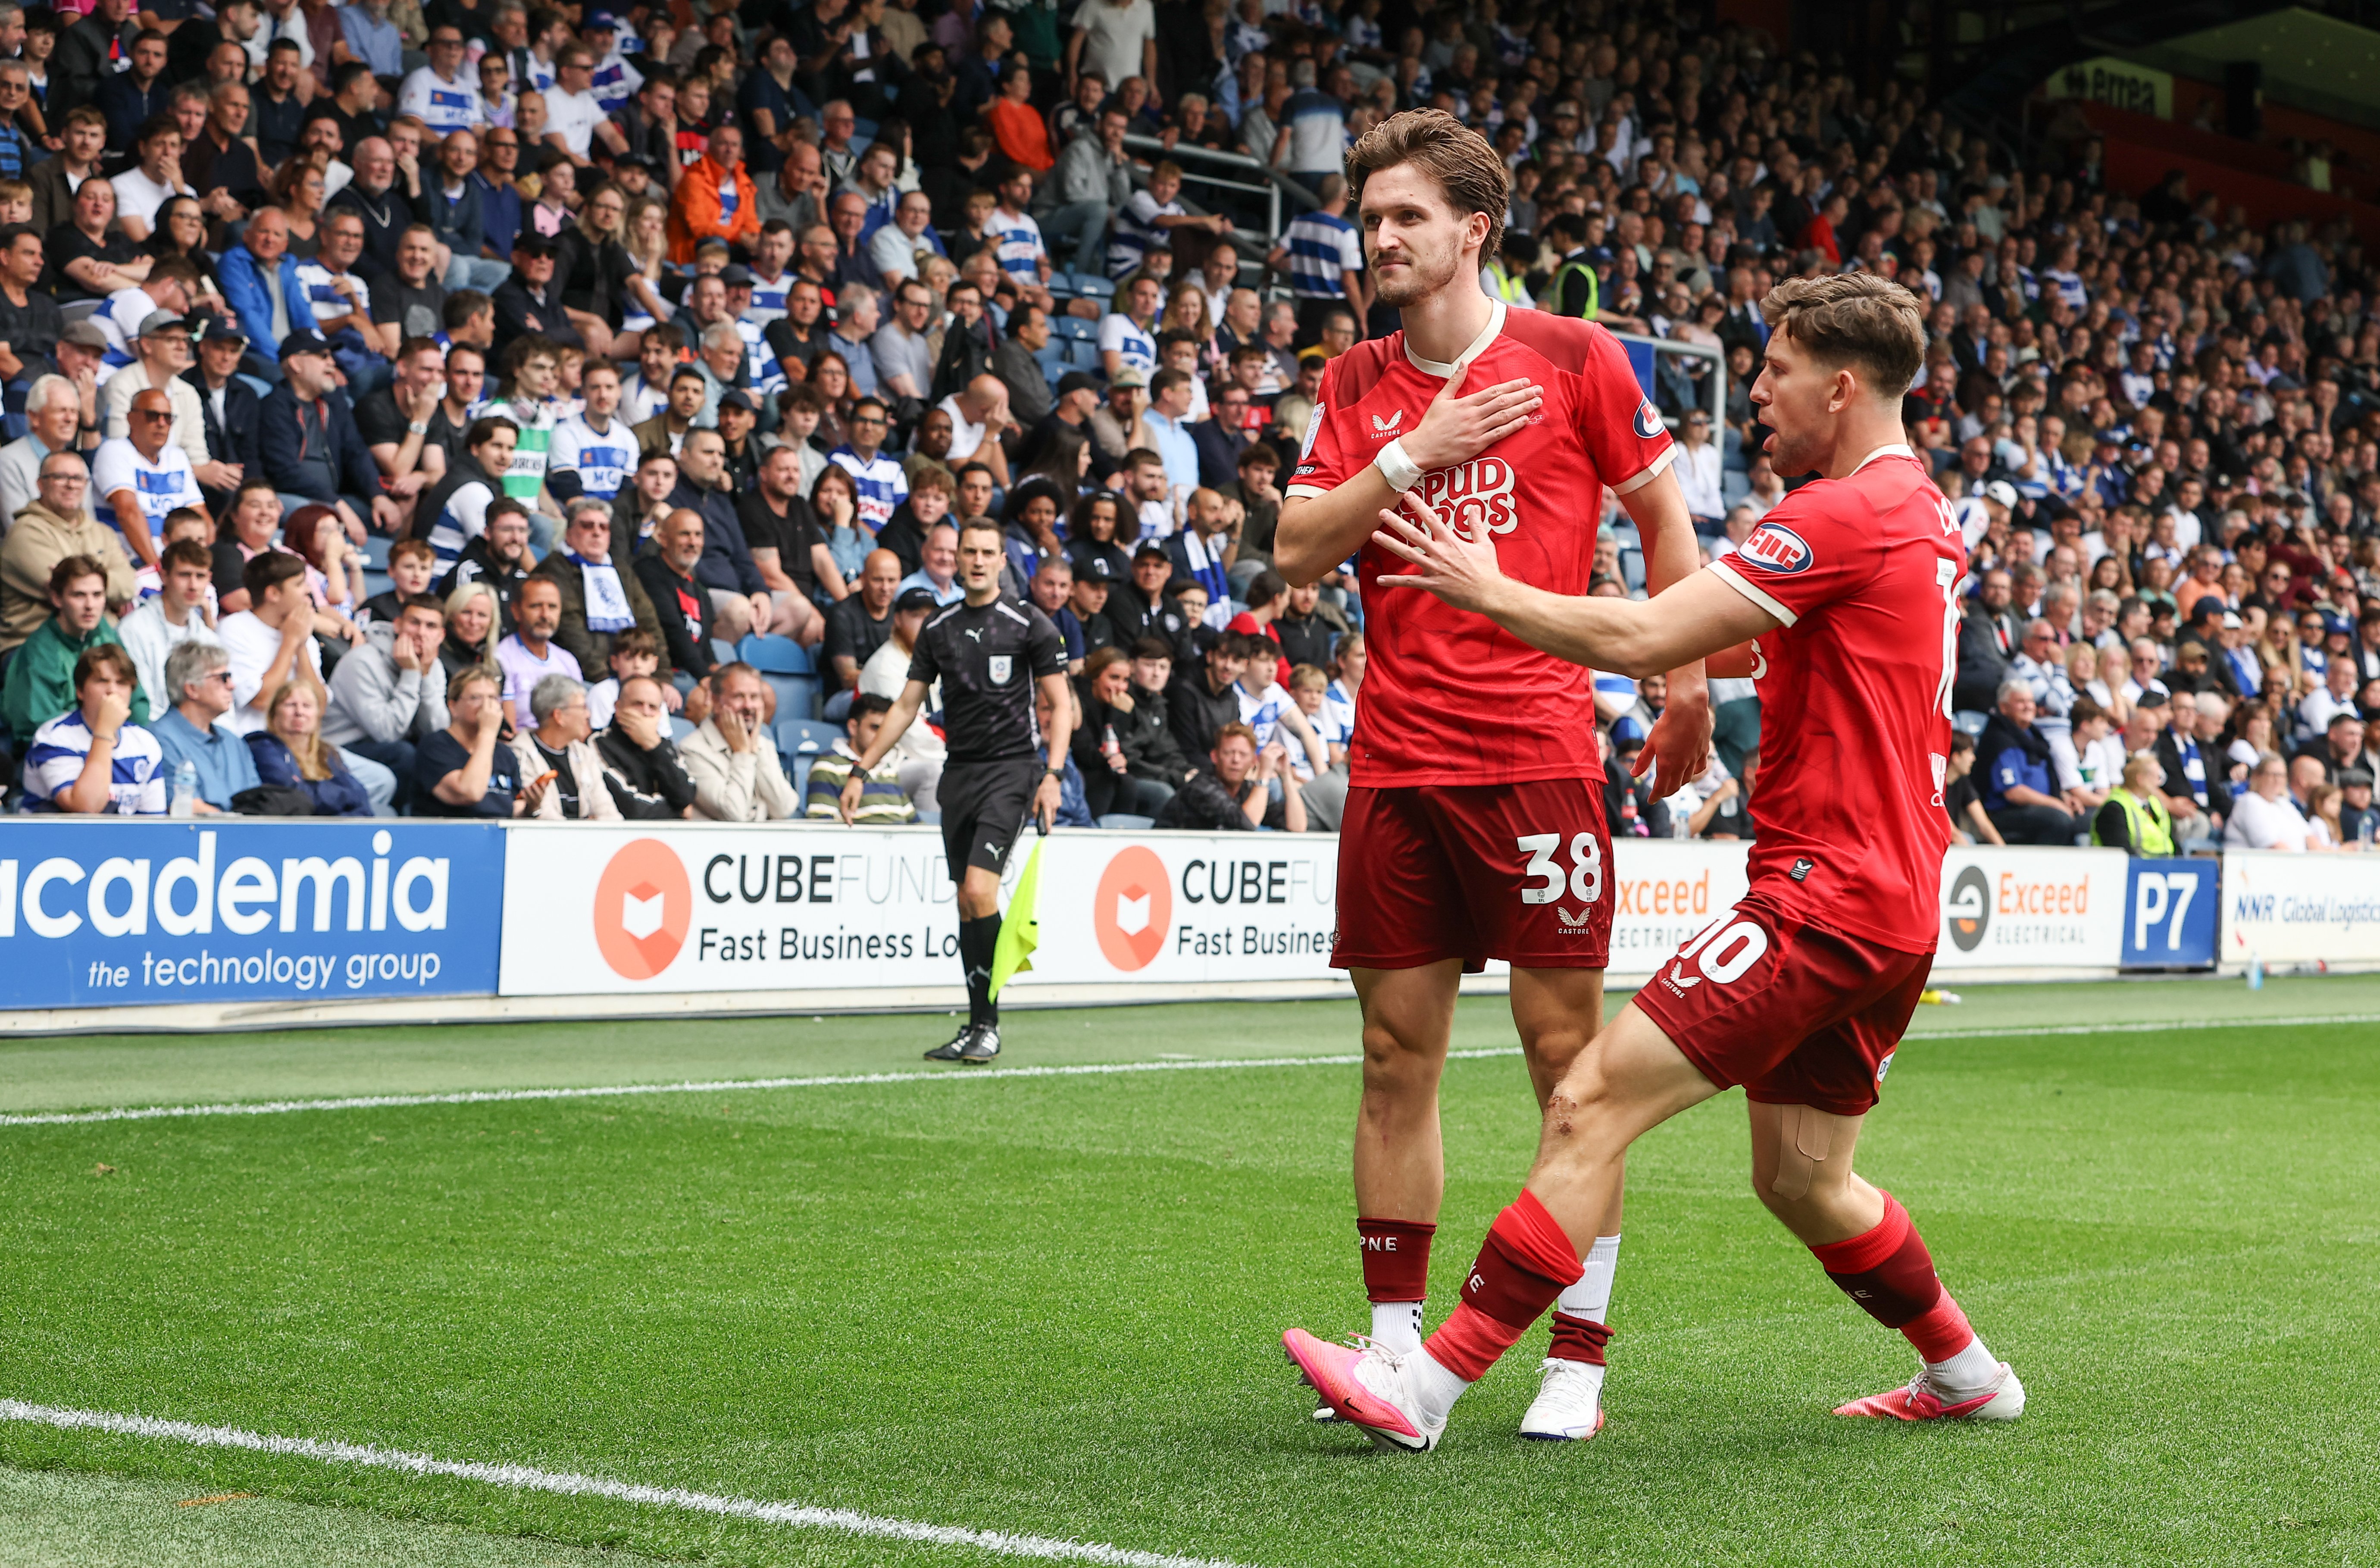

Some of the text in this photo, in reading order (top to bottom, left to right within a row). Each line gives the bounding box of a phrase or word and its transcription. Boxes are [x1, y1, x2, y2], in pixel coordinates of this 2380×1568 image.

[1371, 429, 1400, 439] CASTORE
[1294, 466, 1315, 476] THER
[0, 829, 450, 938] cademia
[1517, 832, 1602, 904] 38
[1615, 868, 1709, 915] xceed
[1999, 873, 2089, 914] Exceed
[2133, 871, 2199, 951] P7
[2234, 894, 2380, 932] NNR Global Logistic
[699, 928, 767, 961] Fast
[779, 925, 913, 960] Business
[1177, 925, 1233, 955] Fast
[1995, 925, 2085, 945] ELECTRICAL
[88, 948, 441, 991] the technology group
[1661, 978, 1686, 998] CASTORE
[1359, 1236, 1398, 1252] PNE
